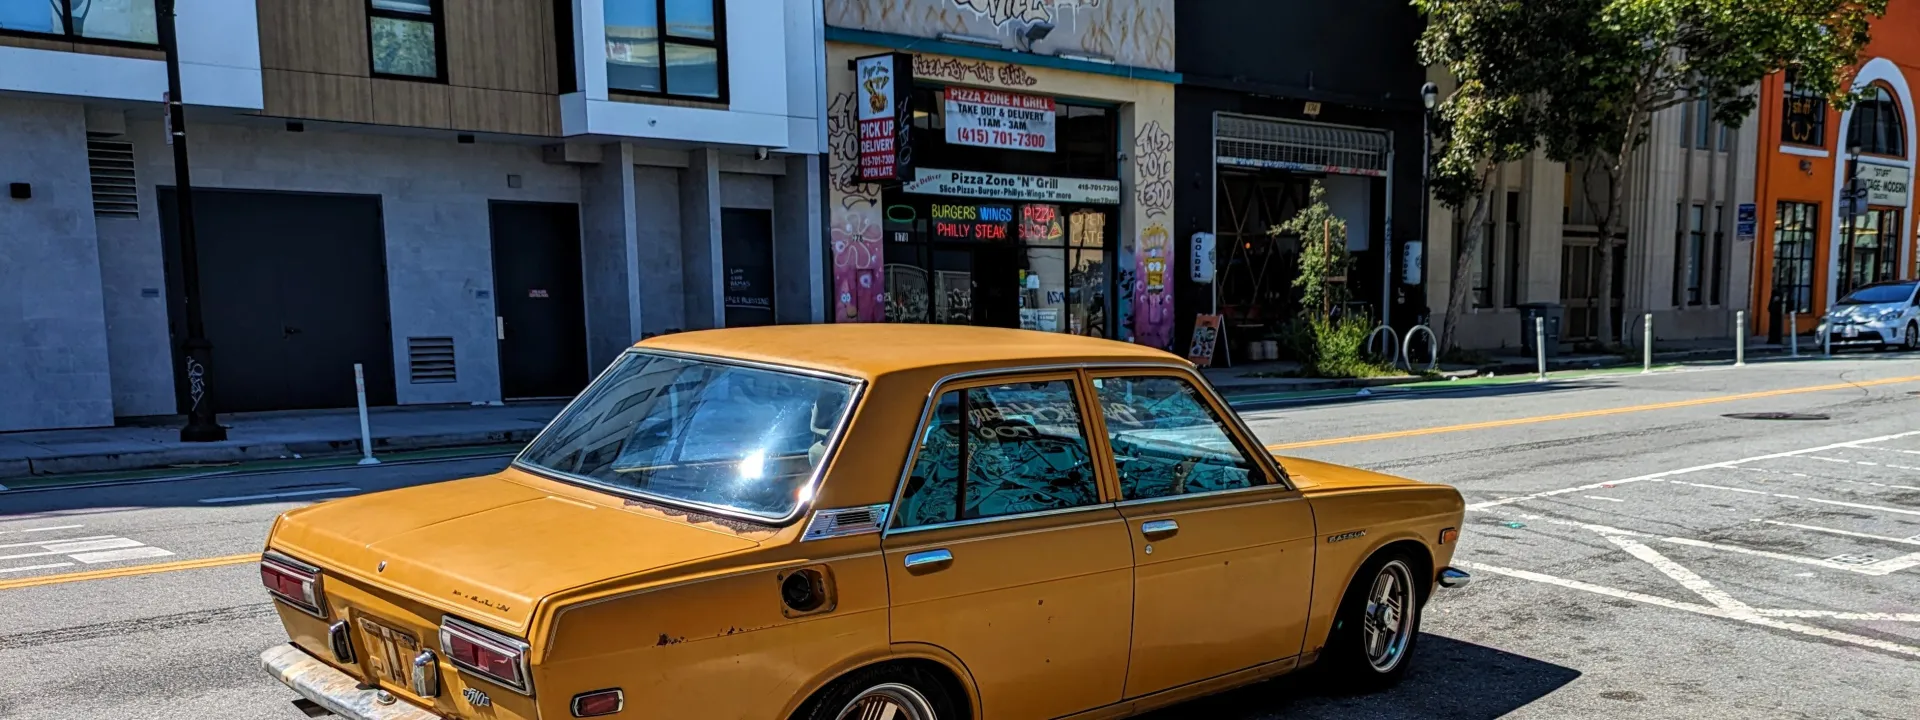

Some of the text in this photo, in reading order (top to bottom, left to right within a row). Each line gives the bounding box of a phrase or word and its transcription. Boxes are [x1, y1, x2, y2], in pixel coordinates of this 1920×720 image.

[951, 89, 1049, 109] PIZZA ZONE N GRILL
[958, 103, 1044, 121] TAKE OUT & DELIVERY
[860, 120, 894, 139] PICK UP
[977, 118, 1001, 128] 11AM
[1008, 120, 1027, 130] 3AM
[957, 127, 1045, 148] (415) 701-7300
[861, 138, 894, 153] DELIVERY
[861, 155, 894, 166] 415-701-7300
[863, 166, 893, 178] OPEN LATE
[920, 174, 941, 185] Deliver
[952, 172, 983, 185] Pizza
[986, 174, 1015, 187] Zone
[1036, 177, 1059, 189] Grill
[1078, 183, 1118, 192] 415-701-7300
[939, 184, 955, 194] Slice
[932, 204, 1012, 222] BURGERS WINGS
[1024, 206, 1055, 221] PIZZA
[1071, 212, 1105, 226] OPEN
[937, 224, 1005, 239] PHILLY STEAK
[1019, 224, 1048, 239] SLICE
[1072, 231, 1103, 243] LATE
[1329, 530, 1367, 543] DATSUN
[467, 688, 485, 706] 510
